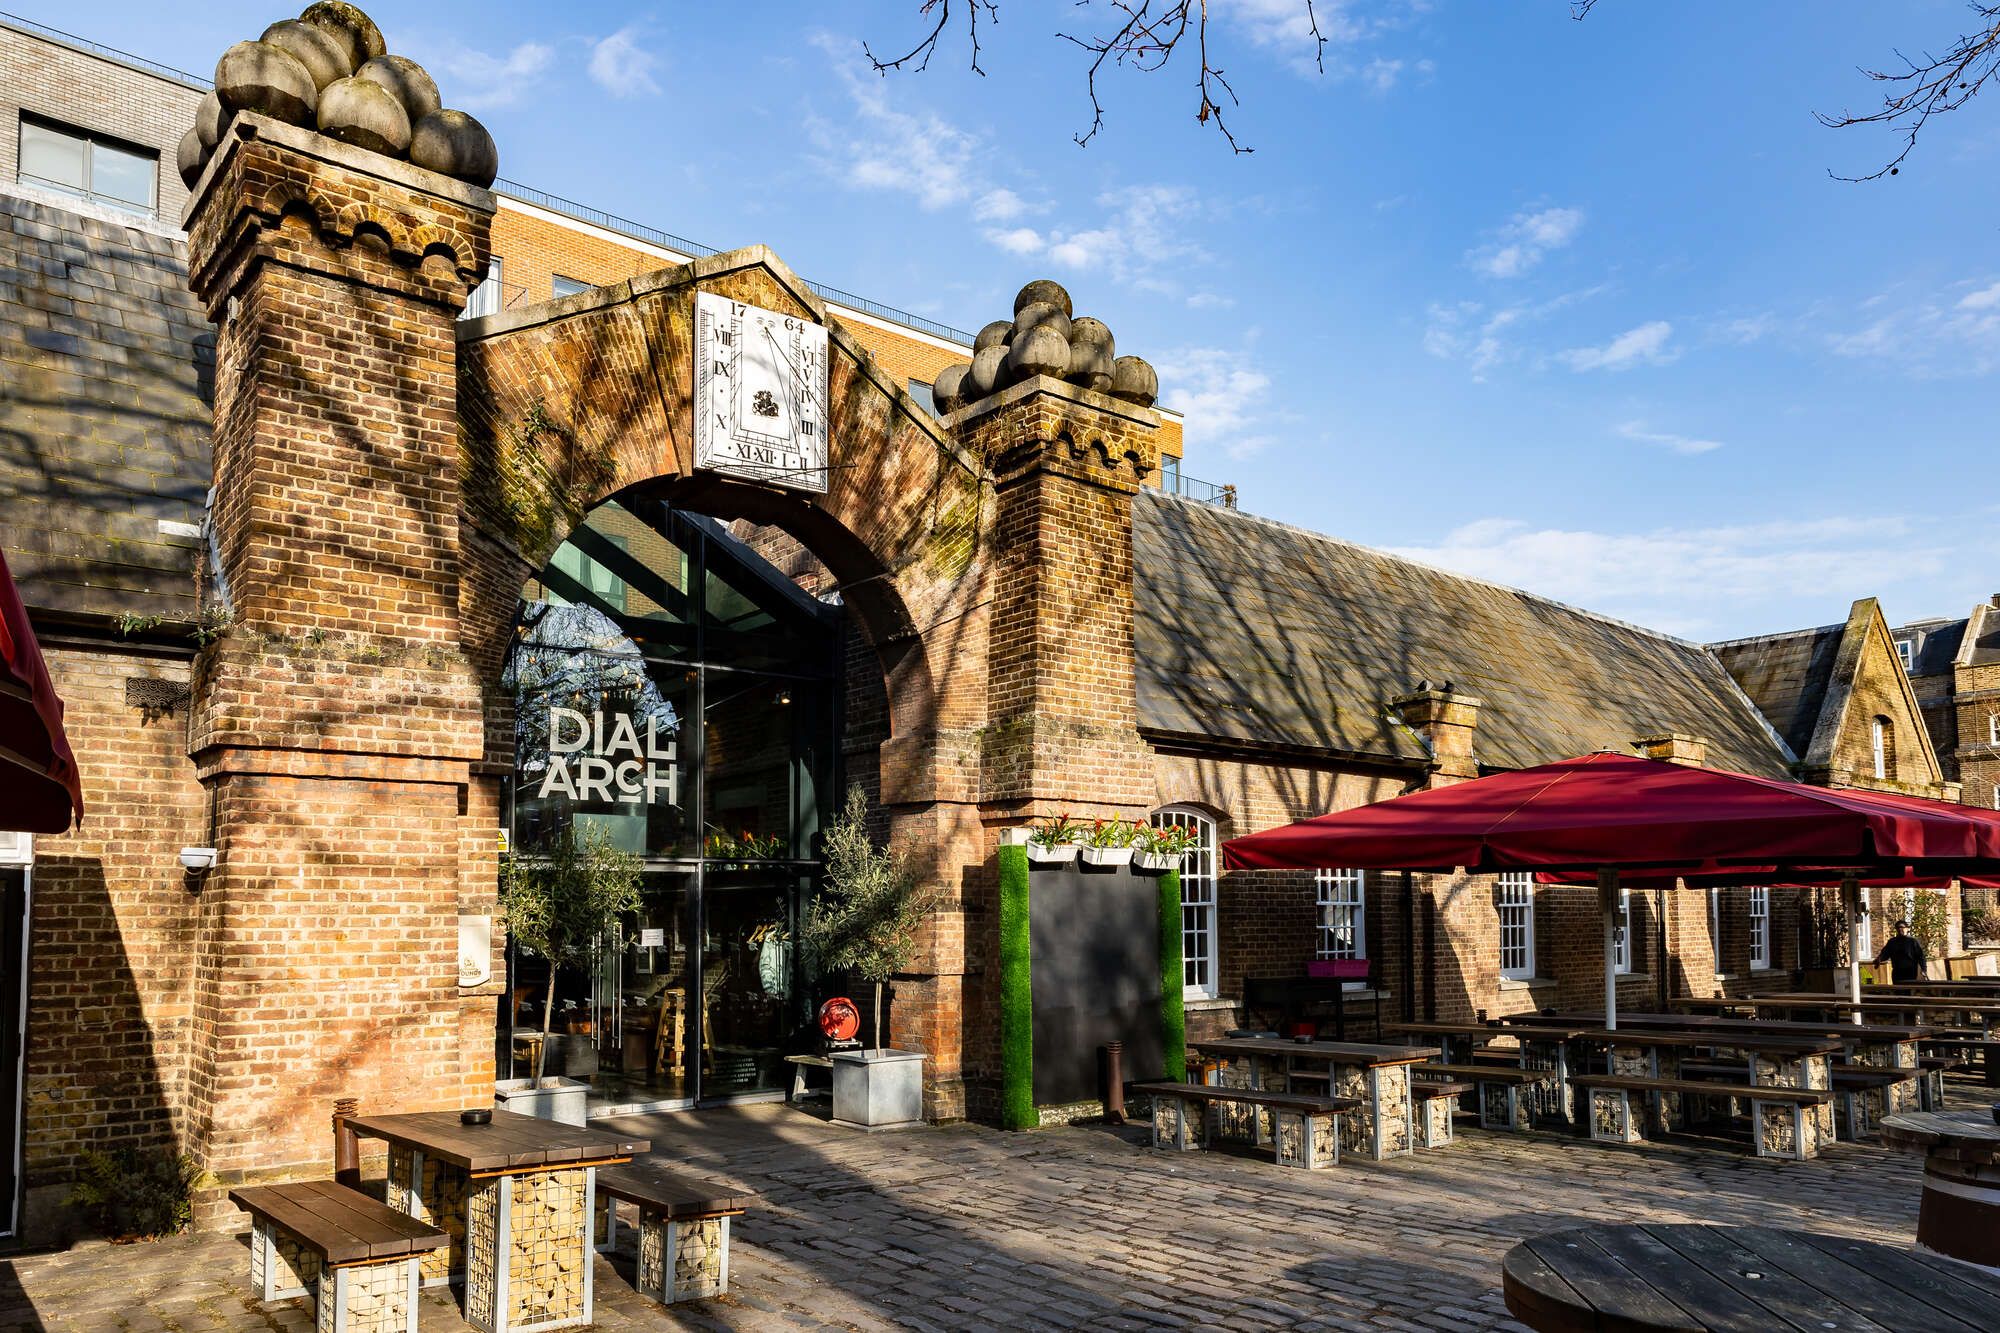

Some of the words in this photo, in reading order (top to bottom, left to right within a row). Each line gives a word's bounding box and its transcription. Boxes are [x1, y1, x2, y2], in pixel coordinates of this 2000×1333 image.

[731, 302, 747, 317] 17
[784, 317, 805, 334] 64
[714, 328, 731, 346] VIII
[801, 349, 814, 365] VI
[714, 361, 730, 377] IX
[803, 368, 812, 381] V
[801, 389, 814, 403] IV
[715, 414, 727, 430] X
[801, 420, 814, 435] III
[550, 706, 677, 760] DIAL
[538, 756, 677, 805] ARCH
